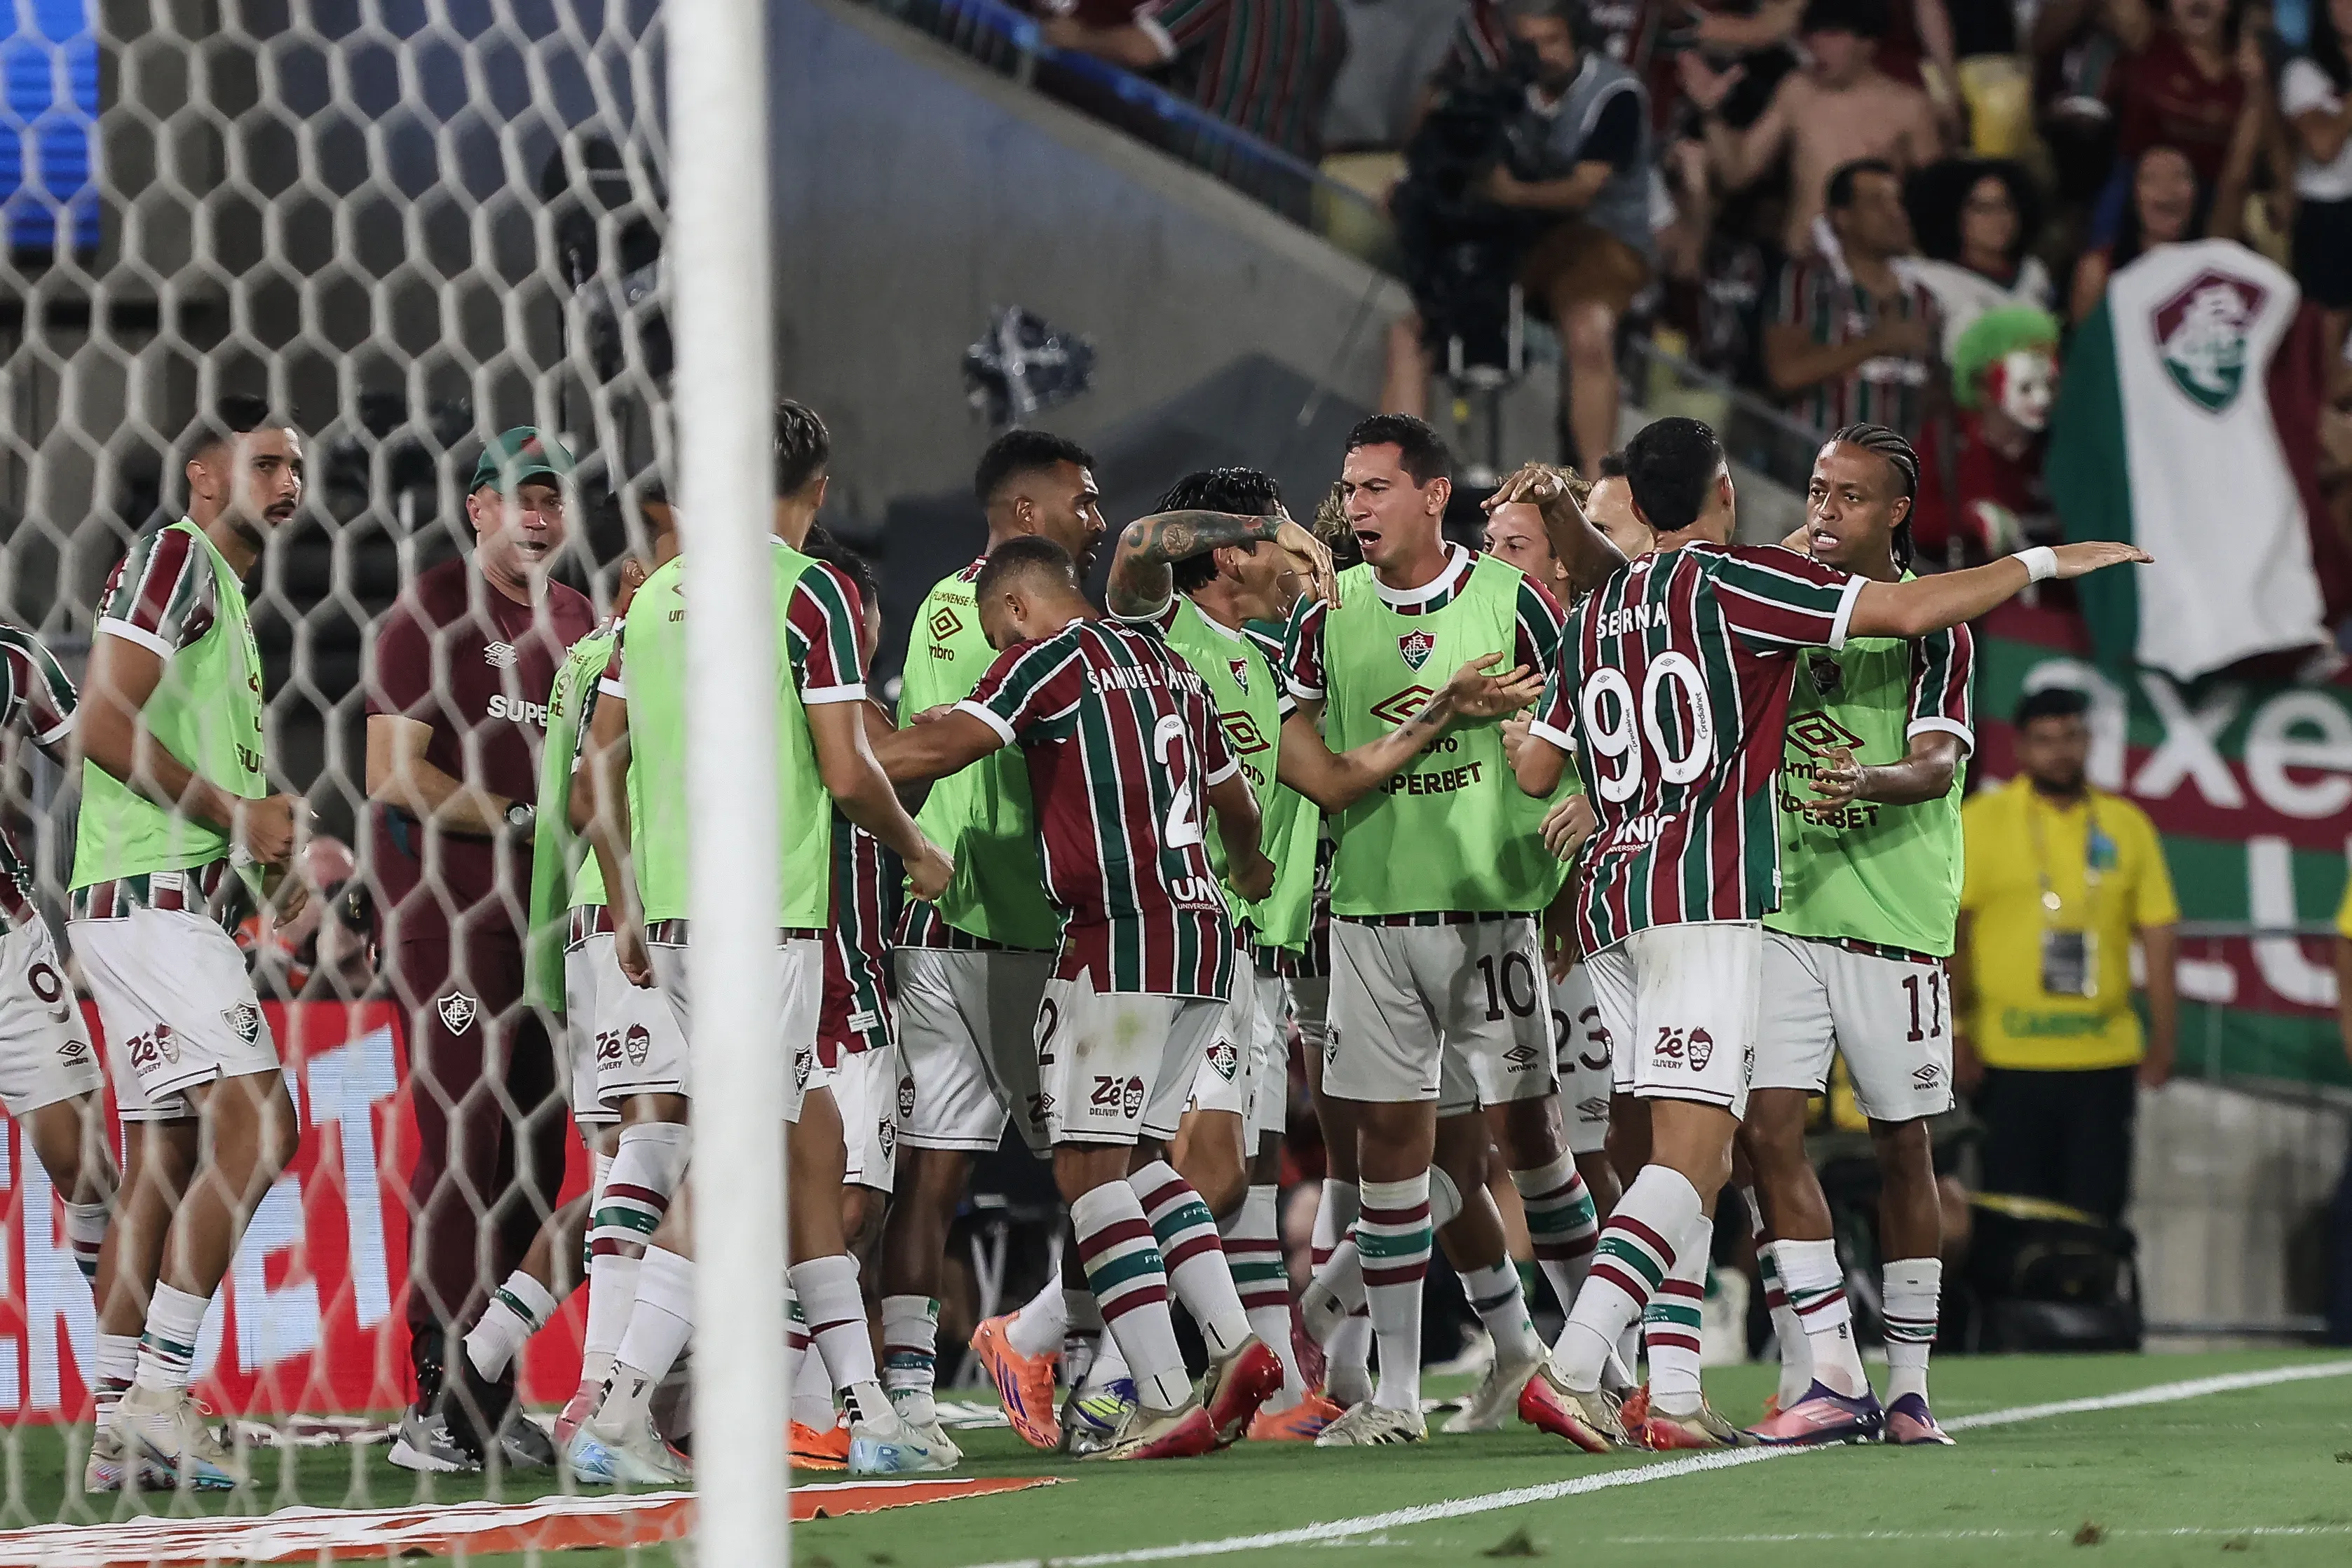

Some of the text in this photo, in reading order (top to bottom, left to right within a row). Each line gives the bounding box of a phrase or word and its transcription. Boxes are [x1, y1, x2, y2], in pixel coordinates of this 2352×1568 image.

[1596, 602, 1668, 639] SERNA
[929, 643, 954, 661] mbro
[1087, 663, 1160, 694] SAMUEL
[487, 694, 549, 727] SUPE
[1582, 650, 1713, 803] 90
[1155, 714, 1201, 849] 2
[1239, 757, 1265, 786] bro
[1380, 761, 1483, 796] PERBET
[1476, 950, 1537, 1021] 10
[1902, 970, 1940, 1042] 11
[595, 1028, 623, 1063] Zé
[1038, 997, 1058, 1065] 2
[1551, 1004, 1612, 1070] 23
[1654, 1026, 1685, 1058] Zé
[125, 1031, 158, 1070] Zé
[1090, 1075, 1124, 1106] Zé
